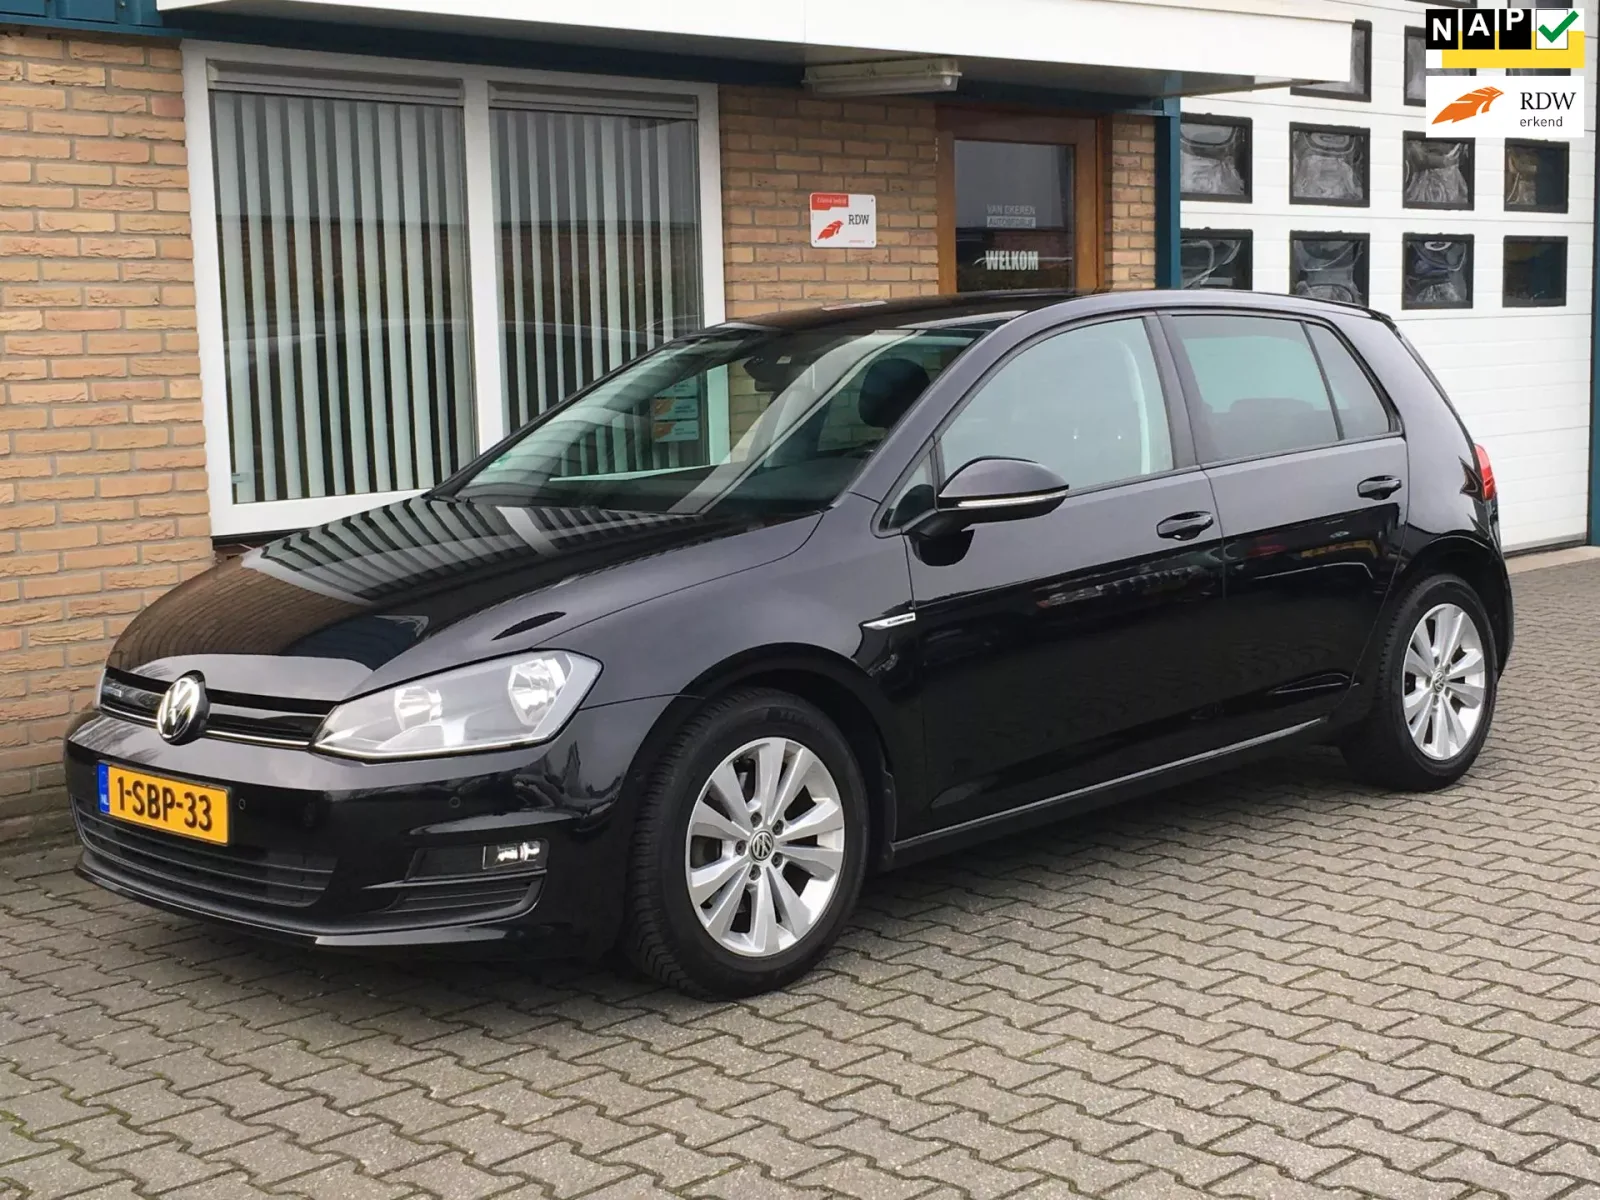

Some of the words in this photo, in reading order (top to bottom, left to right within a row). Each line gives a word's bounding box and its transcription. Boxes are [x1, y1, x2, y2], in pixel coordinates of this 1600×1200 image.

[848, 214, 870, 226] RDW
[985, 250, 1039, 271] WELKOM
[117, 776, 213, 832] 1-SBP-33
